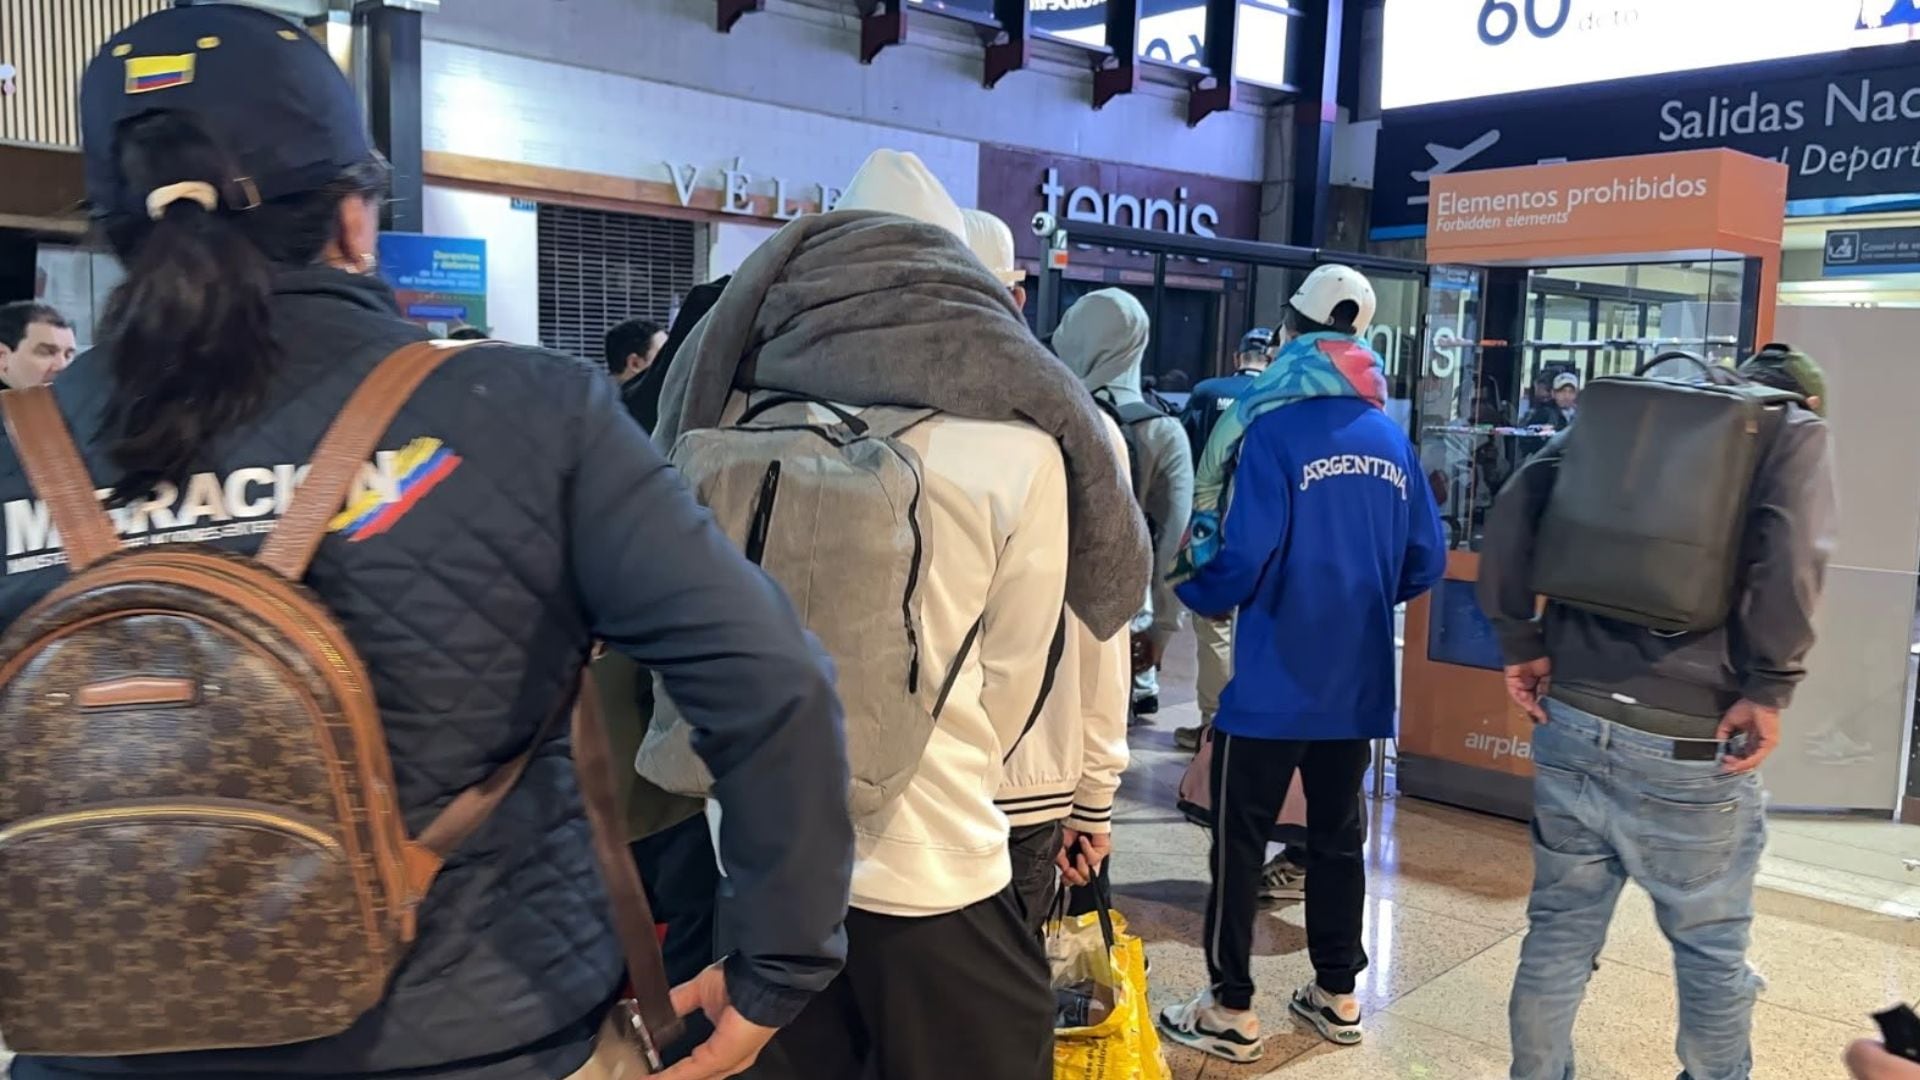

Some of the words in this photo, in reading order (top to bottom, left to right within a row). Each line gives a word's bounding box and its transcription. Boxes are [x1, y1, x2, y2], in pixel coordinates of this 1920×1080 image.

[1658, 91, 1805, 142] Salidas
[1042, 167, 1219, 263] tennis
[1437, 189, 1558, 215] Elementos
[1567, 174, 1707, 212] prohibidos
[1436, 213, 1501, 232] Forbidden
[1505, 210, 1569, 228] elements
[1299, 454, 1408, 501] ARGENTINA
[1464, 732, 1535, 760] airpla
